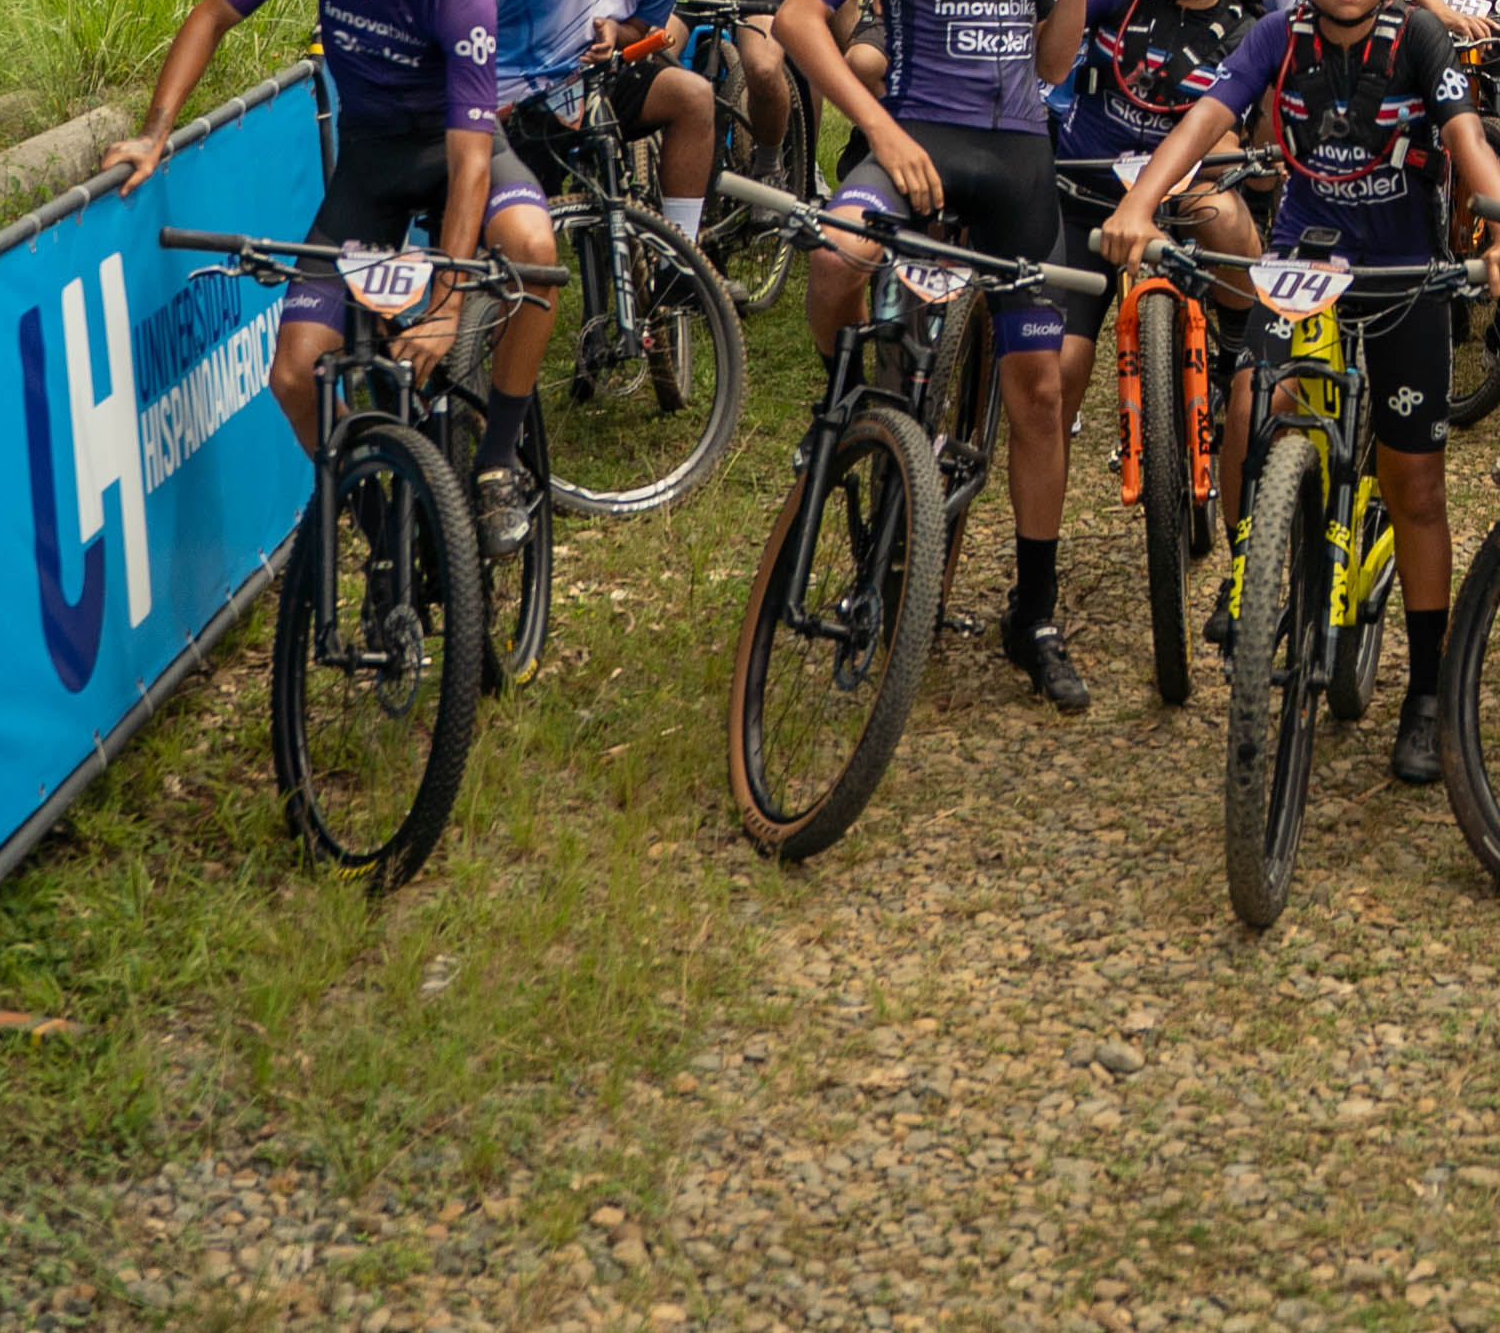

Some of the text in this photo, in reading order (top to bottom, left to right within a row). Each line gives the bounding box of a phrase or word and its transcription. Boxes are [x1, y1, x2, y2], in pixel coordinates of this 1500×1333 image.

[957, 29, 1030, 53] Skoler
[362, 264, 415, 296] 06
[1269, 270, 1332, 303] 04
